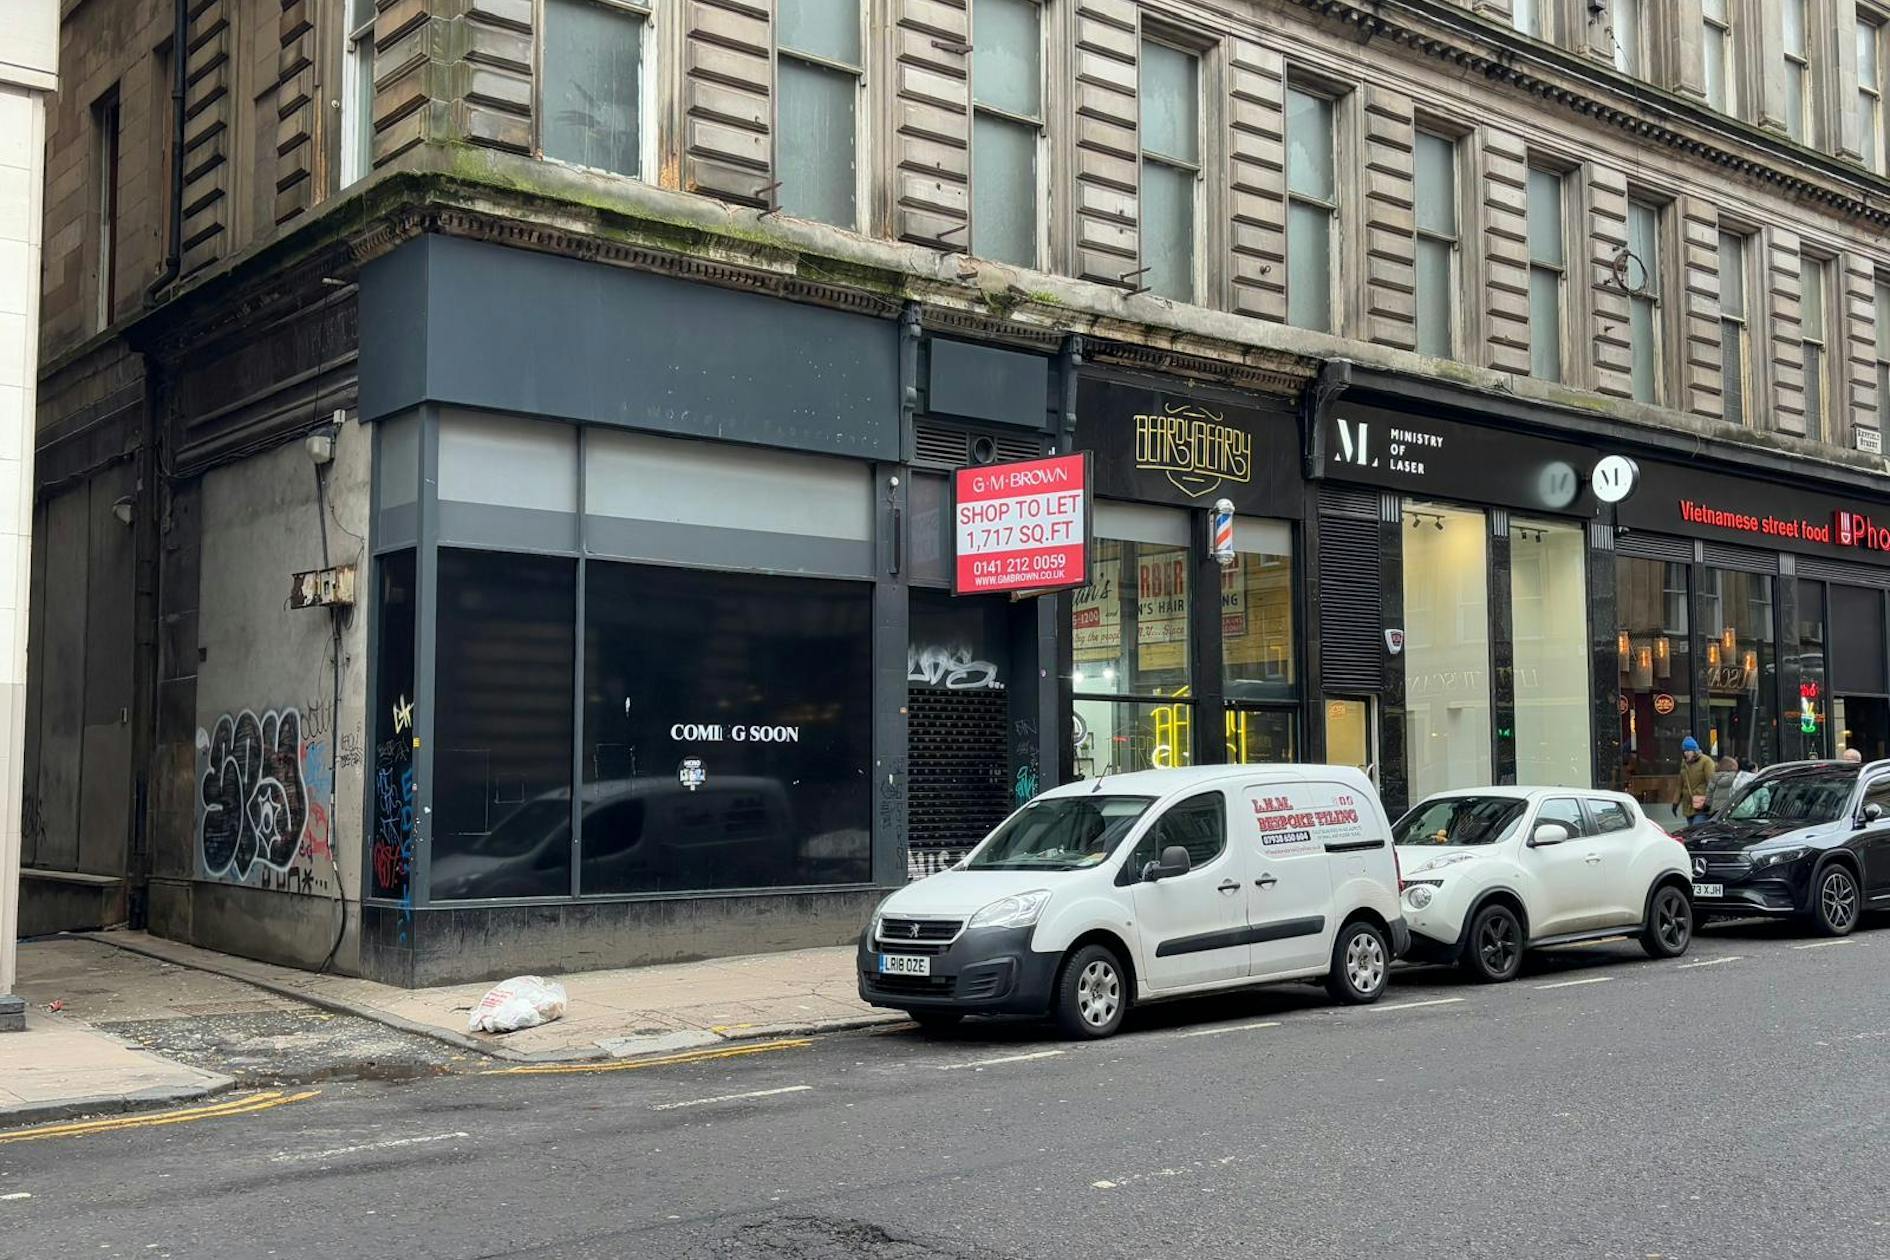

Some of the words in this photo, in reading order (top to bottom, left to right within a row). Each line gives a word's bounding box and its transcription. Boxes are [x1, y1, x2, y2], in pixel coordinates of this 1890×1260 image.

[1390, 428, 1443, 448] MINISTRY
[1390, 444, 1406, 456] OF
[1390, 461, 1425, 475] LASER
[960, 502, 1010, 525] SHOP
[1015, 499, 1041, 519] TO
[1046, 494, 1080, 516] LET
[1680, 500, 1759, 531] Vietnamese
[1762, 515, 1799, 538] street
[1801, 520, 1829, 542] food
[967, 527, 1013, 551] 1,717
[1019, 520, 1073, 544] SQ.FT
[1853, 513, 1890, 551] Pho
[973, 559, 1002, 575] 0141
[1007, 557, 1030, 572] 212
[1033, 553, 1066, 570] 0059
[975, 569, 1065, 586] WWW.GMBROWN.CO.UK
[1158, 599, 1184, 613] HAIR
[750, 726, 799, 742] SOON
[1703, 885, 1722, 895] XJH
[885, 957, 904, 972] LR18
[906, 957, 925, 973] OZE
